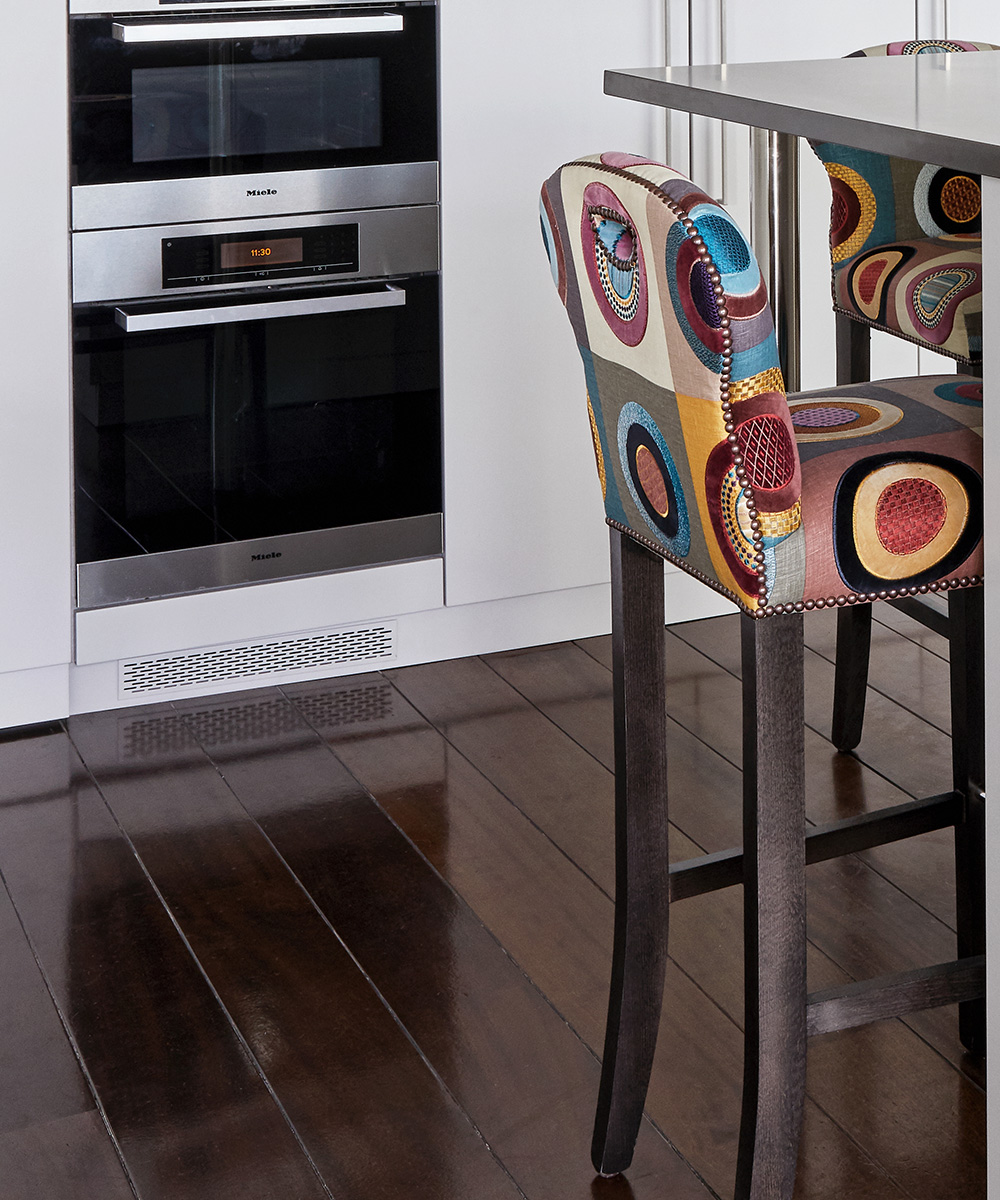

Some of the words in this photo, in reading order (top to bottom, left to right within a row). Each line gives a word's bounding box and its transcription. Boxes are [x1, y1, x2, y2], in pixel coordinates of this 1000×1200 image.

[246, 189, 278, 197] Miele
[250, 247, 272, 257] 11:30
[251, 552, 282, 562] Miele
